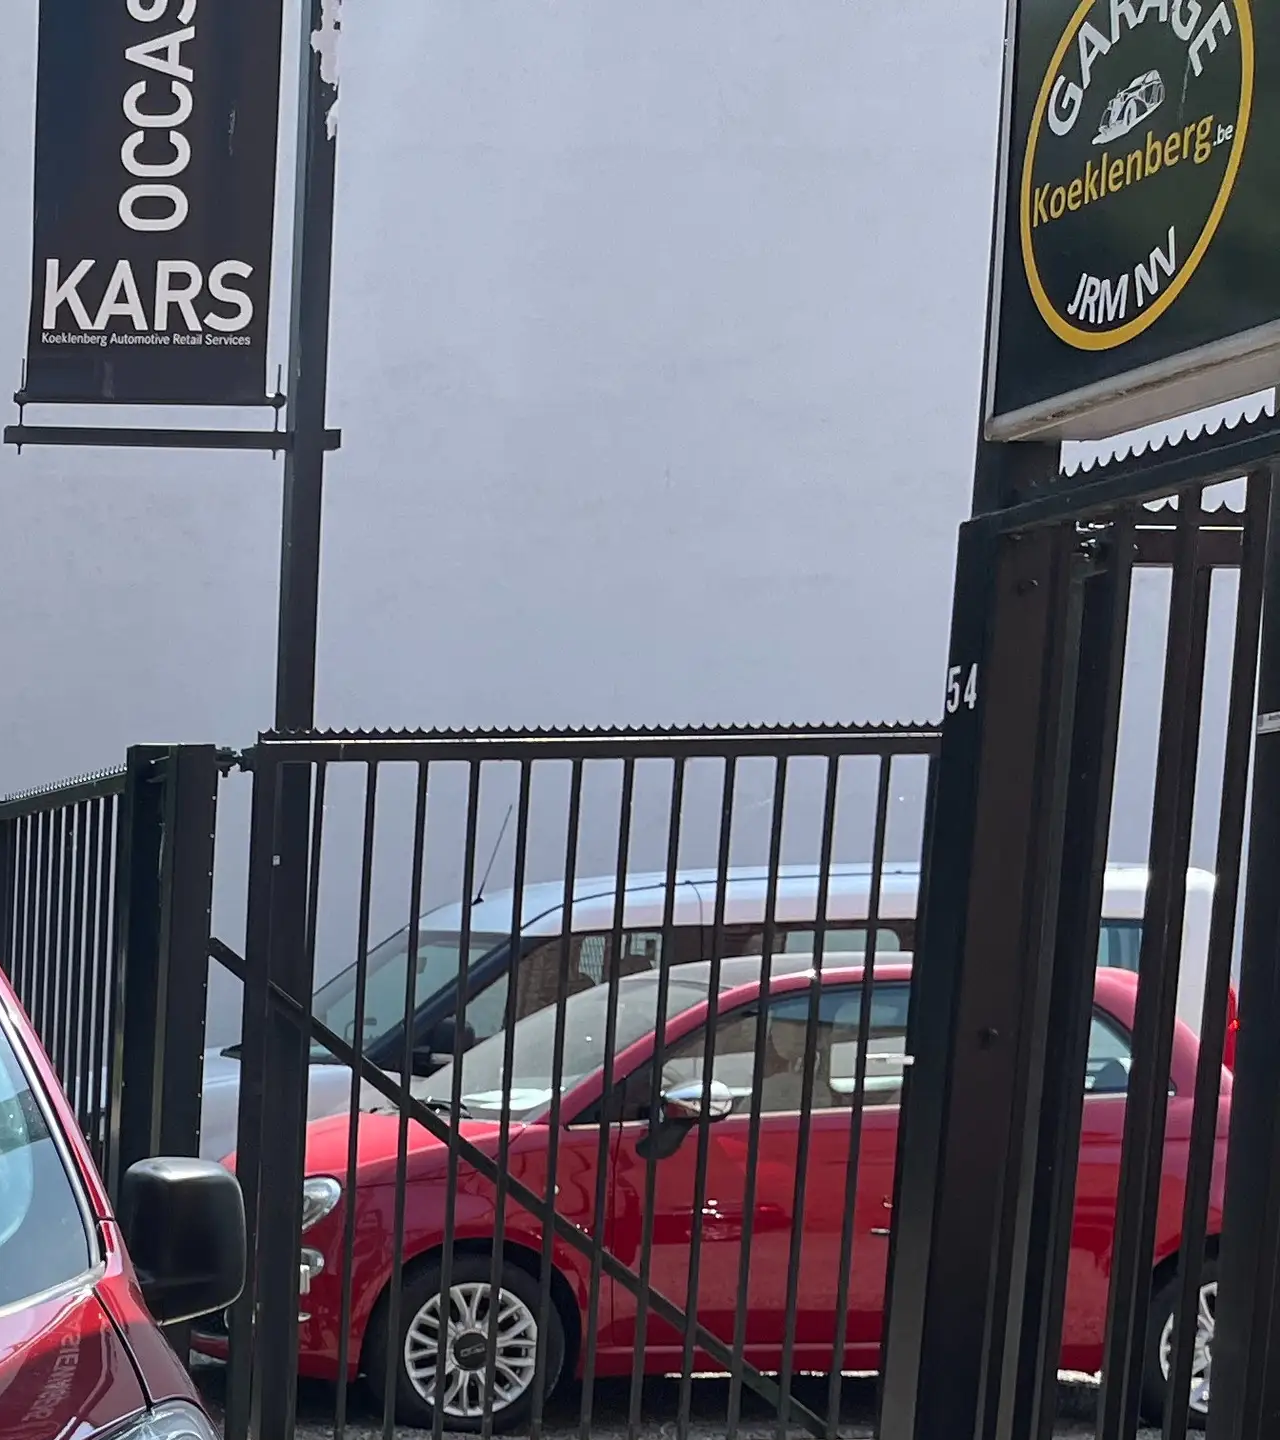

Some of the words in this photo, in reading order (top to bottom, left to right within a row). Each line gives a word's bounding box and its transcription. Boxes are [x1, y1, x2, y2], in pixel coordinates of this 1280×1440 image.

[42, 258, 254, 332] KARS
[1067, 272, 1129, 324] JRM
[1134, 225, 1176, 308] NV
[41, 331, 108, 347] Koeklenberg
[110, 332, 170, 346] Automotive
[173, 333, 203, 346] Retail
[205, 333, 251, 346] Services
[946, 662, 978, 714] 54
